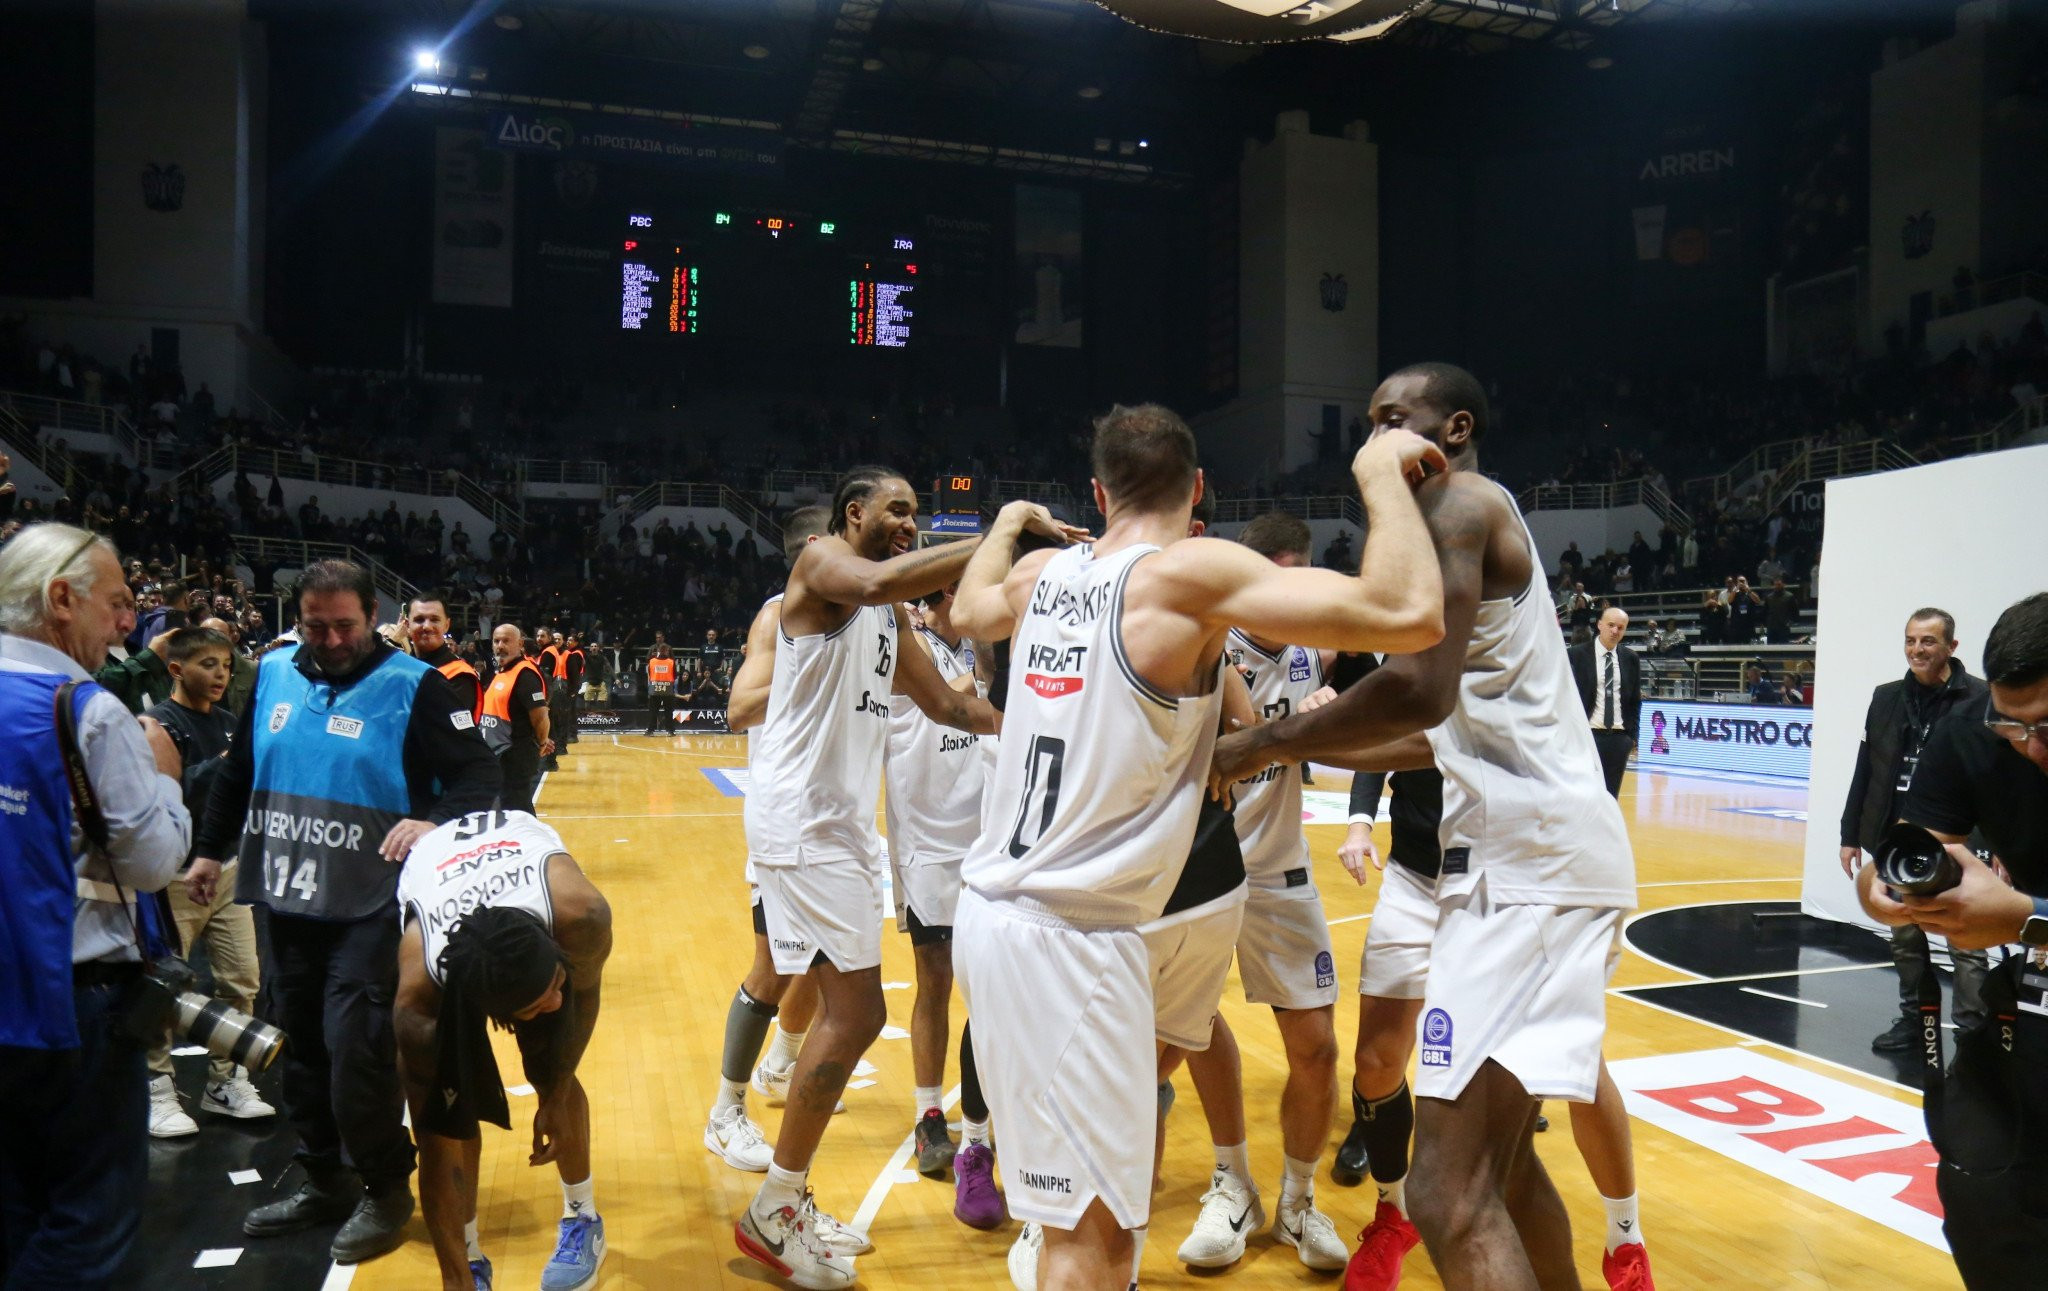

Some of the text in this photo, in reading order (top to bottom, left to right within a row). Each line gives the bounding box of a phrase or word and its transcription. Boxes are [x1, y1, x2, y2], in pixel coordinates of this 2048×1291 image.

[498, 114, 563, 151] Διός
[593, 134, 662, 152] ΠΡΟΣΤΑΣΙΑ
[666, 143, 693, 157] είναι
[757, 153, 776, 164] του
[630, 216, 652, 227] PBC
[715, 213, 730, 225] 84
[772, 230, 778, 239] 4
[820, 222, 835, 234] 82
[893, 239, 913, 250] IRA
[942, 518, 977, 528] Stoiximan
[1028, 643, 1087, 672] KRAFT
[1291, 671, 1310, 680] GBL
[330, 716, 361, 733] TRUST
[1675, 716, 1780, 746] MAESTRO
[438, 848, 522, 886] KRAFT
[428, 865, 534, 934] JACKSON
[774, 938, 806, 952] ΓΙΑΝΝΙΡΗΣ
[1923, 1015, 1938, 1069] SONY
[1423, 1050, 1450, 1065] GBL
[1018, 1168, 1072, 1194] ΓΙΑΝΝΙΡΗΣ
